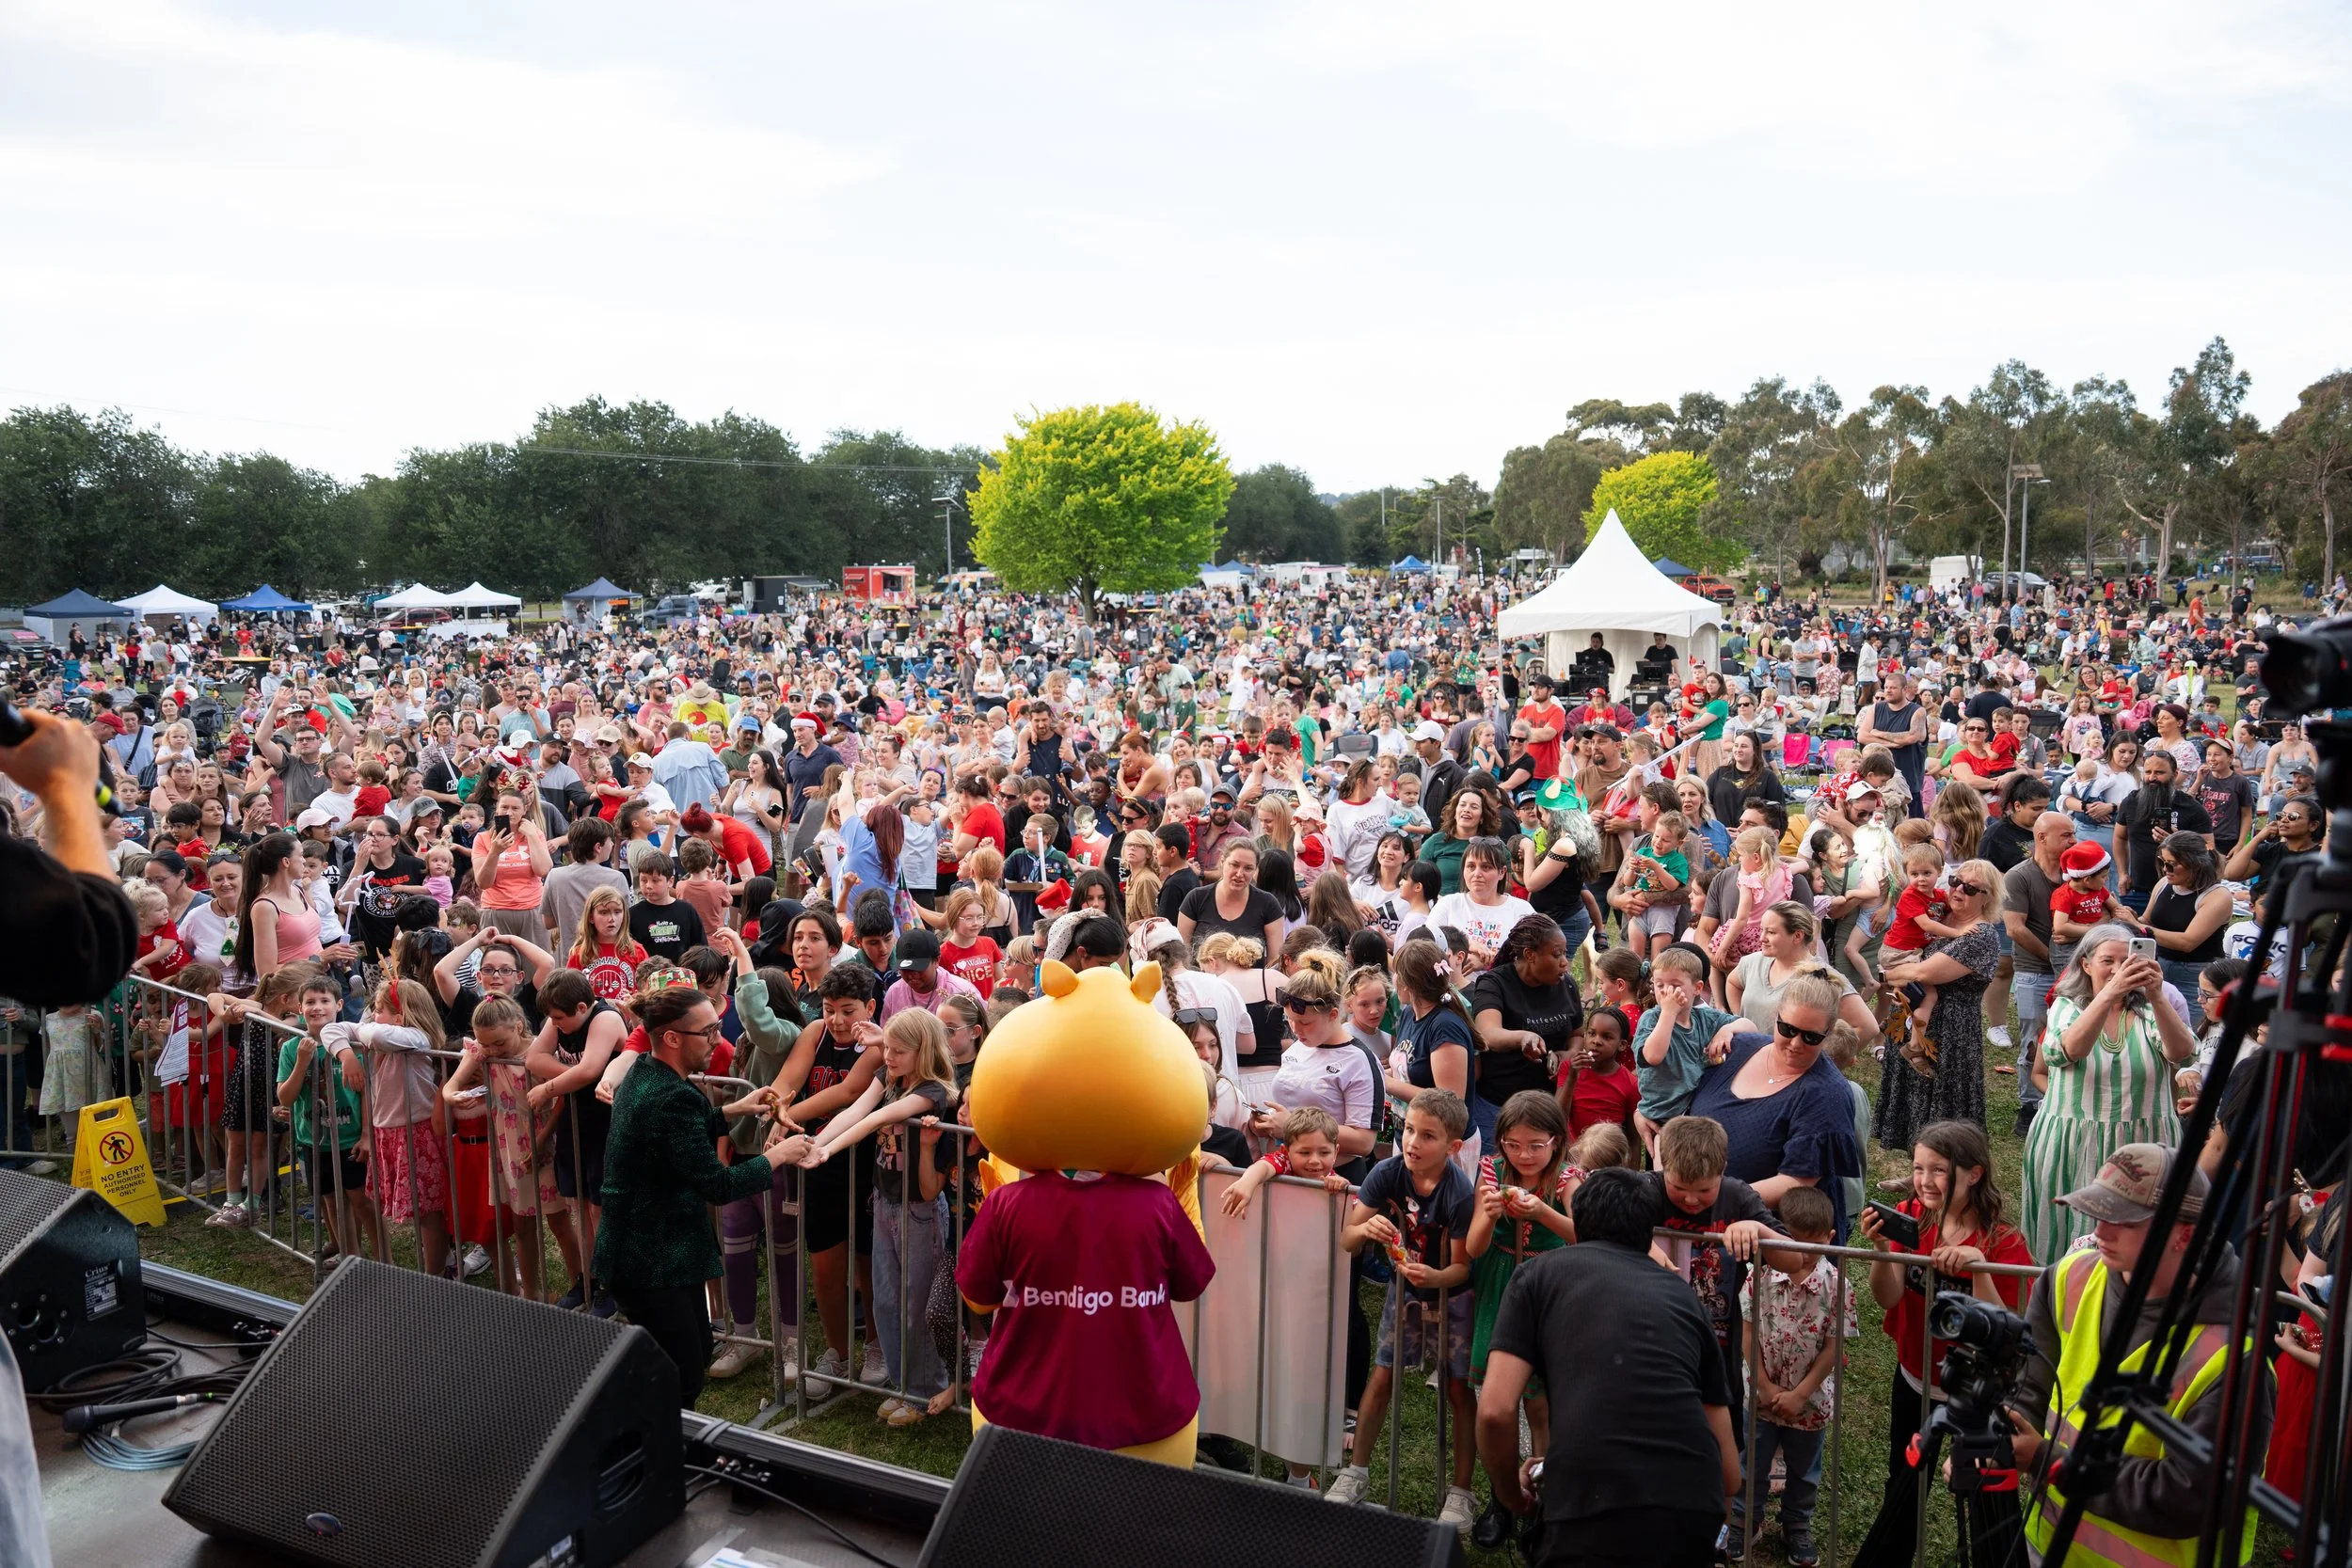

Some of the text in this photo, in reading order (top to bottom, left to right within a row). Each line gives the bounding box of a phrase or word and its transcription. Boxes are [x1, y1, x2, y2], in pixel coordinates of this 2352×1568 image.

[362, 874, 410, 887] AMONES
[1468, 928, 1502, 939] SEASON
[2233, 934, 2288, 954] SOIC
[960, 965, 993, 982] NICE
[1526, 1013, 1567, 1024] Perfectly
[101, 1174, 115, 1182] NO
[116, 1164, 145, 1179] ENTRY
[103, 1172, 146, 1189] AUTHORISED
[106, 1179, 147, 1196] PERSONNEL
[119, 1187, 136, 1197] ONLY
[1025, 1283, 1166, 1315] Bendigo Bank
